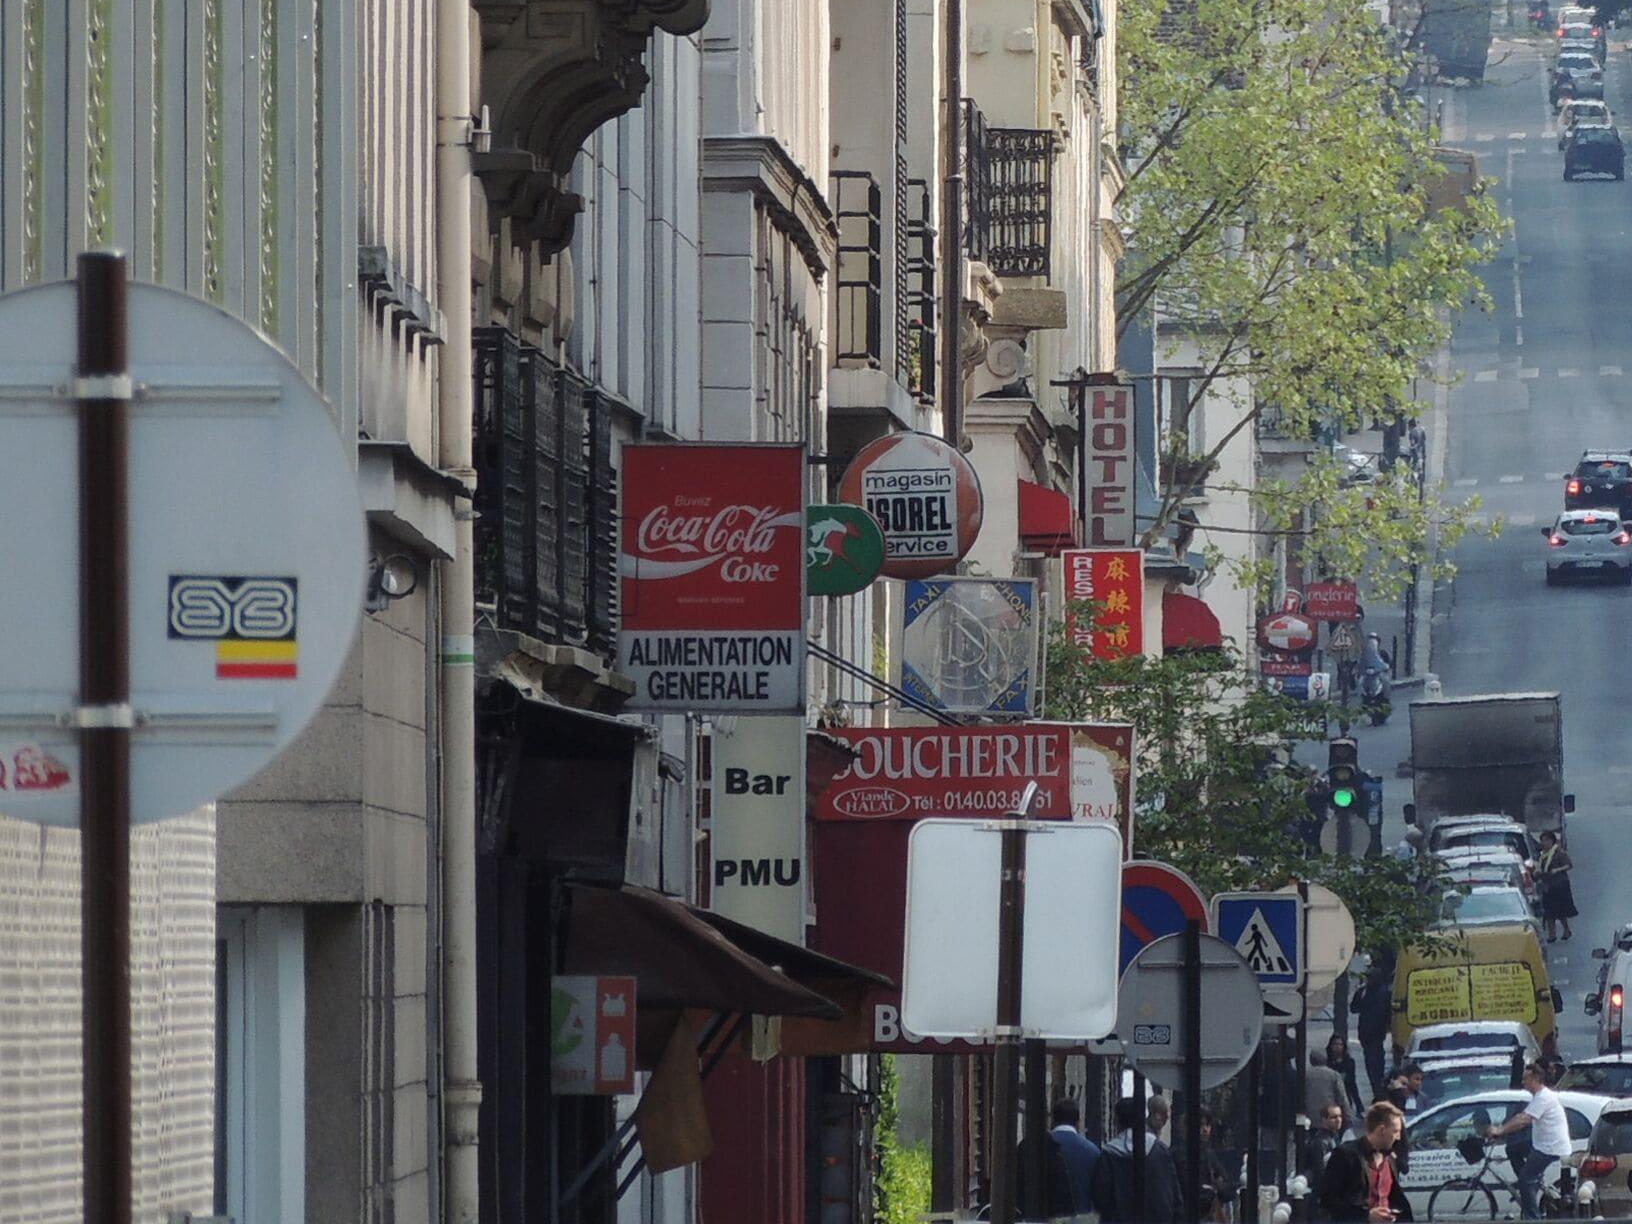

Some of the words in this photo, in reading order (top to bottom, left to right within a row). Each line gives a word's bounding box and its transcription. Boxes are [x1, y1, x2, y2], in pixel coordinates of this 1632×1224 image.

[865, 470, 951, 491] magasin
[1091, 390, 1127, 546] HOTEL
[866, 495, 952, 533] ISOREL
[638, 504, 781, 554] Coca-Cola
[886, 538, 948, 553] ervice
[720, 556, 780, 583] Coke
[909, 583, 943, 615] TAXI
[628, 636, 792, 666] ALIMENTATION
[647, 670, 770, 701] GENERALE
[725, 767, 791, 796] Bar
[851, 790, 895, 801] Viande
[844, 800, 898, 812] HALAL
[715, 858, 800, 887] PMU
